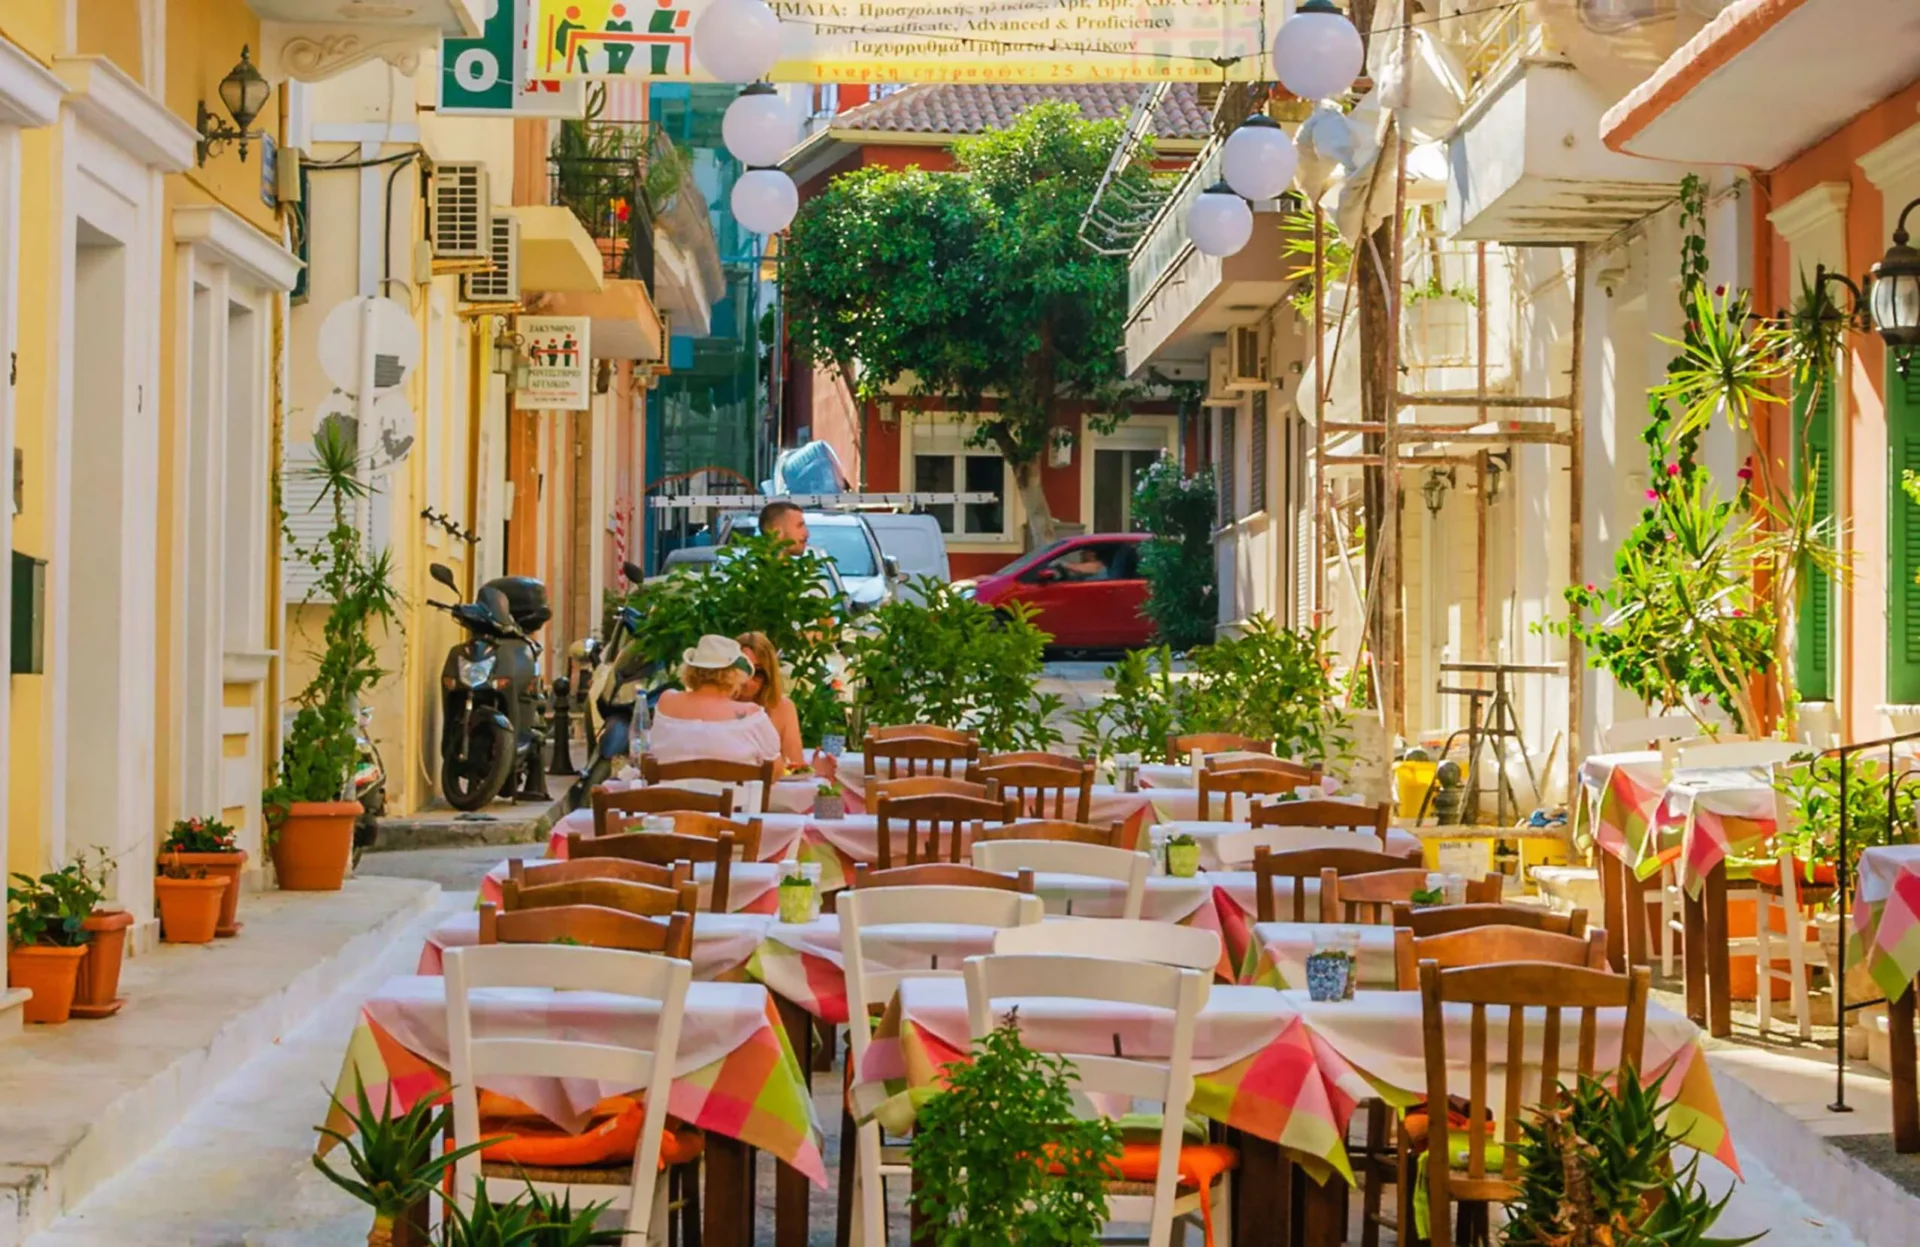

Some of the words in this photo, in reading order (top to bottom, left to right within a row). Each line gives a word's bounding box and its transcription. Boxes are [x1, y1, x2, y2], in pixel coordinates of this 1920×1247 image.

[815, 22, 857, 36] First
[966, 17, 1050, 31] Advanced
[1056, 18, 1069, 30] &
[1077, 15, 1173, 32] Proficiency
[1051, 64, 1074, 78] 25
